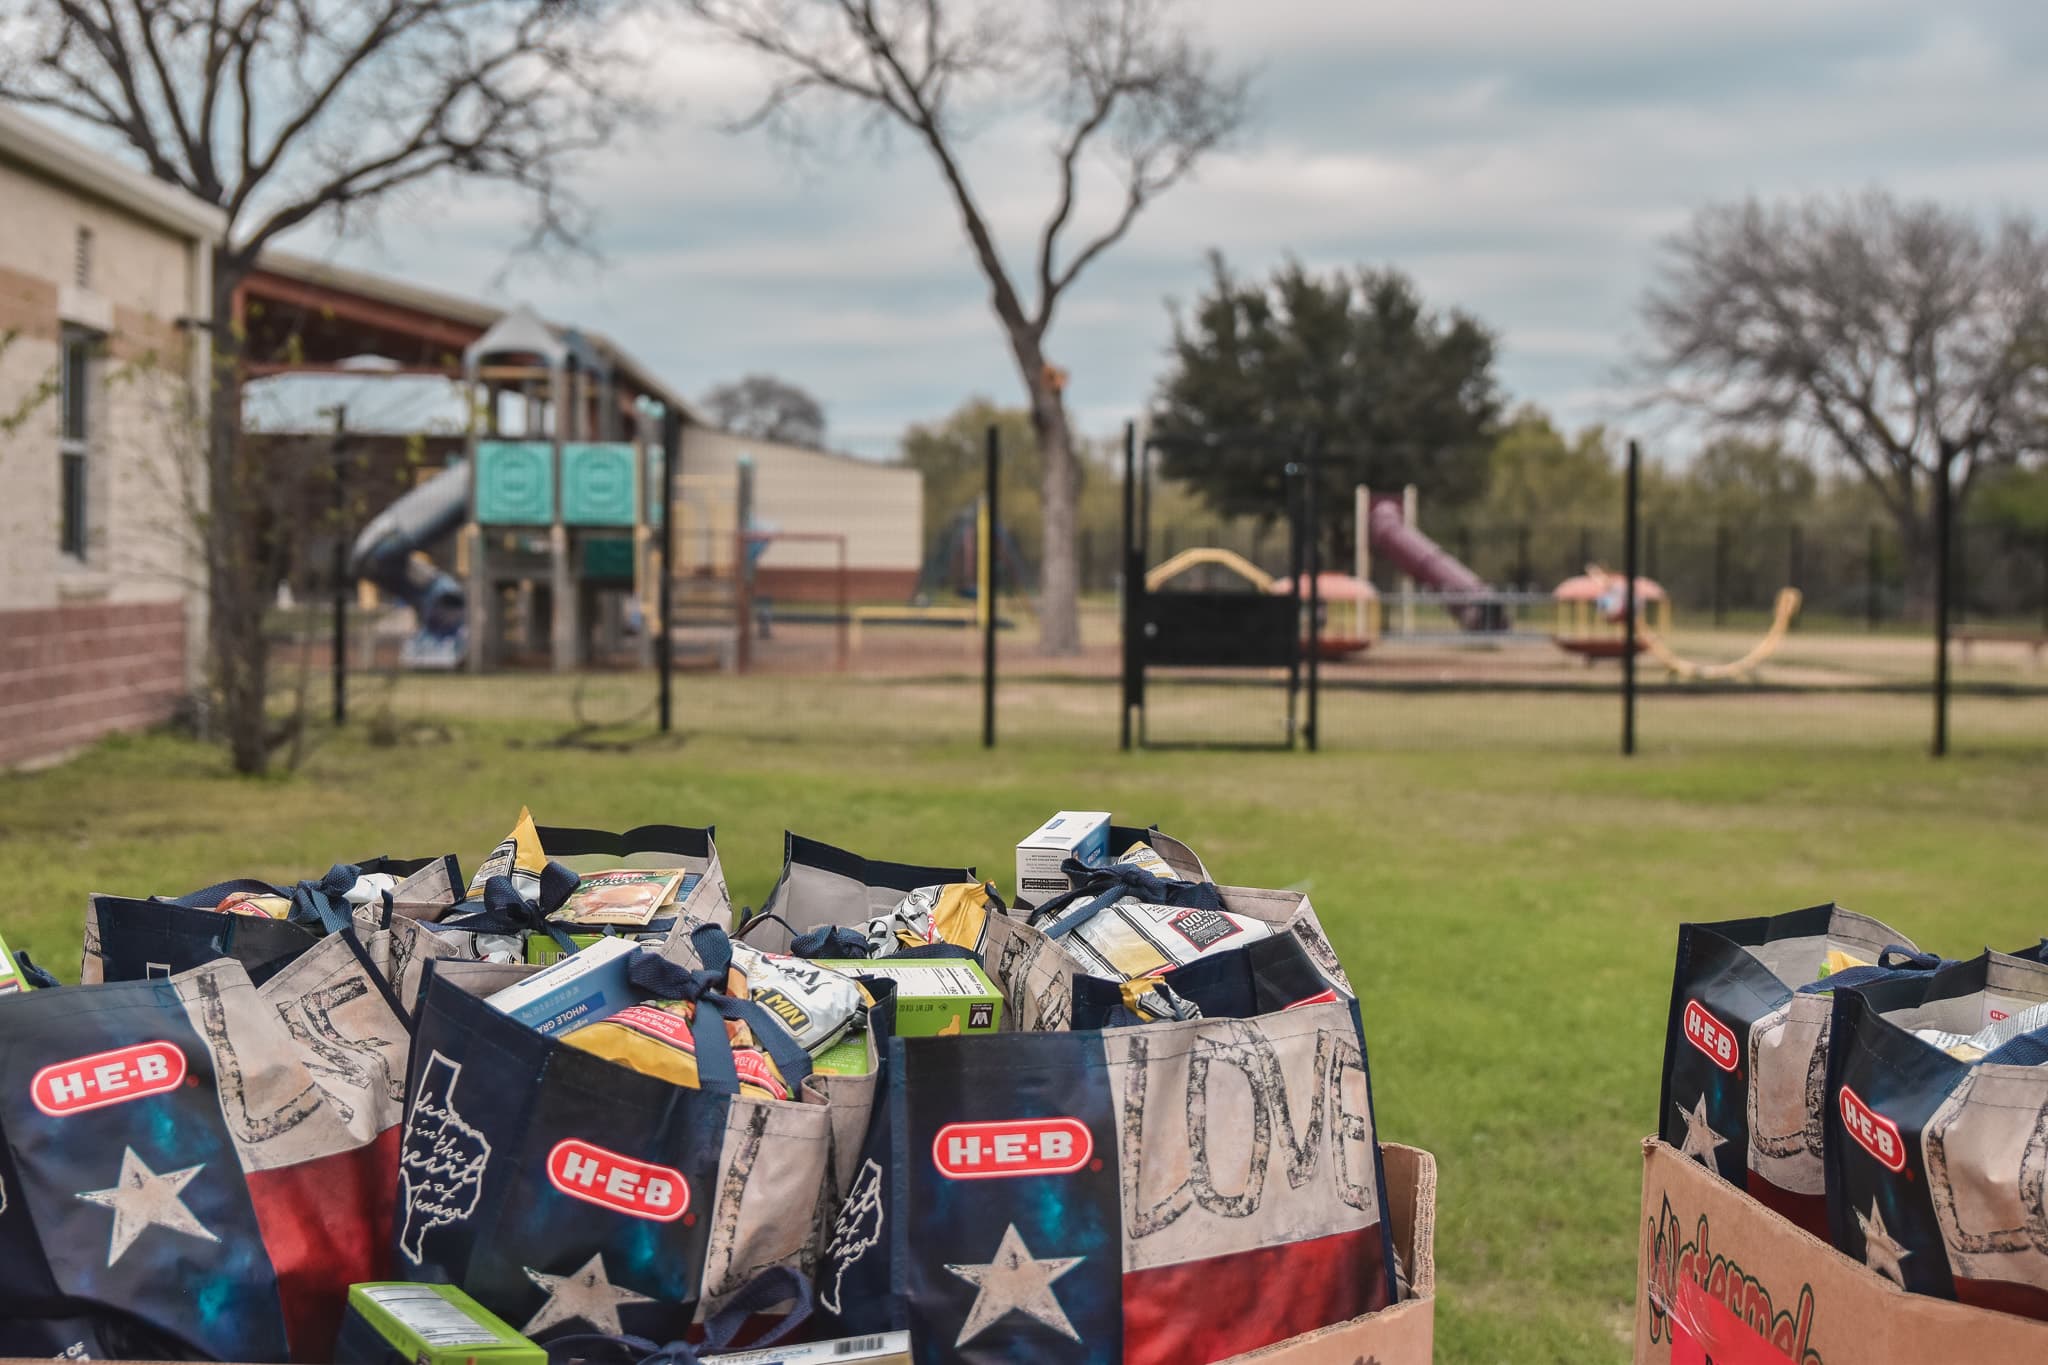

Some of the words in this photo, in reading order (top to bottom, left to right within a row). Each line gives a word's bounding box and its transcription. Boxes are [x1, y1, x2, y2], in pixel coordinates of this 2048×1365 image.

[555, 1003, 588, 1025] WHOLE
[768, 992, 807, 1027] MIN
[1688, 1010, 1731, 1061] H-E-B
[49, 1053, 170, 1105] H-E-B
[948, 1130, 1073, 1166] H-E-B
[1123, 1028, 1374, 1240] LOVE
[1844, 1095, 1895, 1158] H-E-B
[433, 1136, 467, 1163] the
[433, 1182, 463, 1202] of
[561, 1152, 673, 1207] H-E-B
